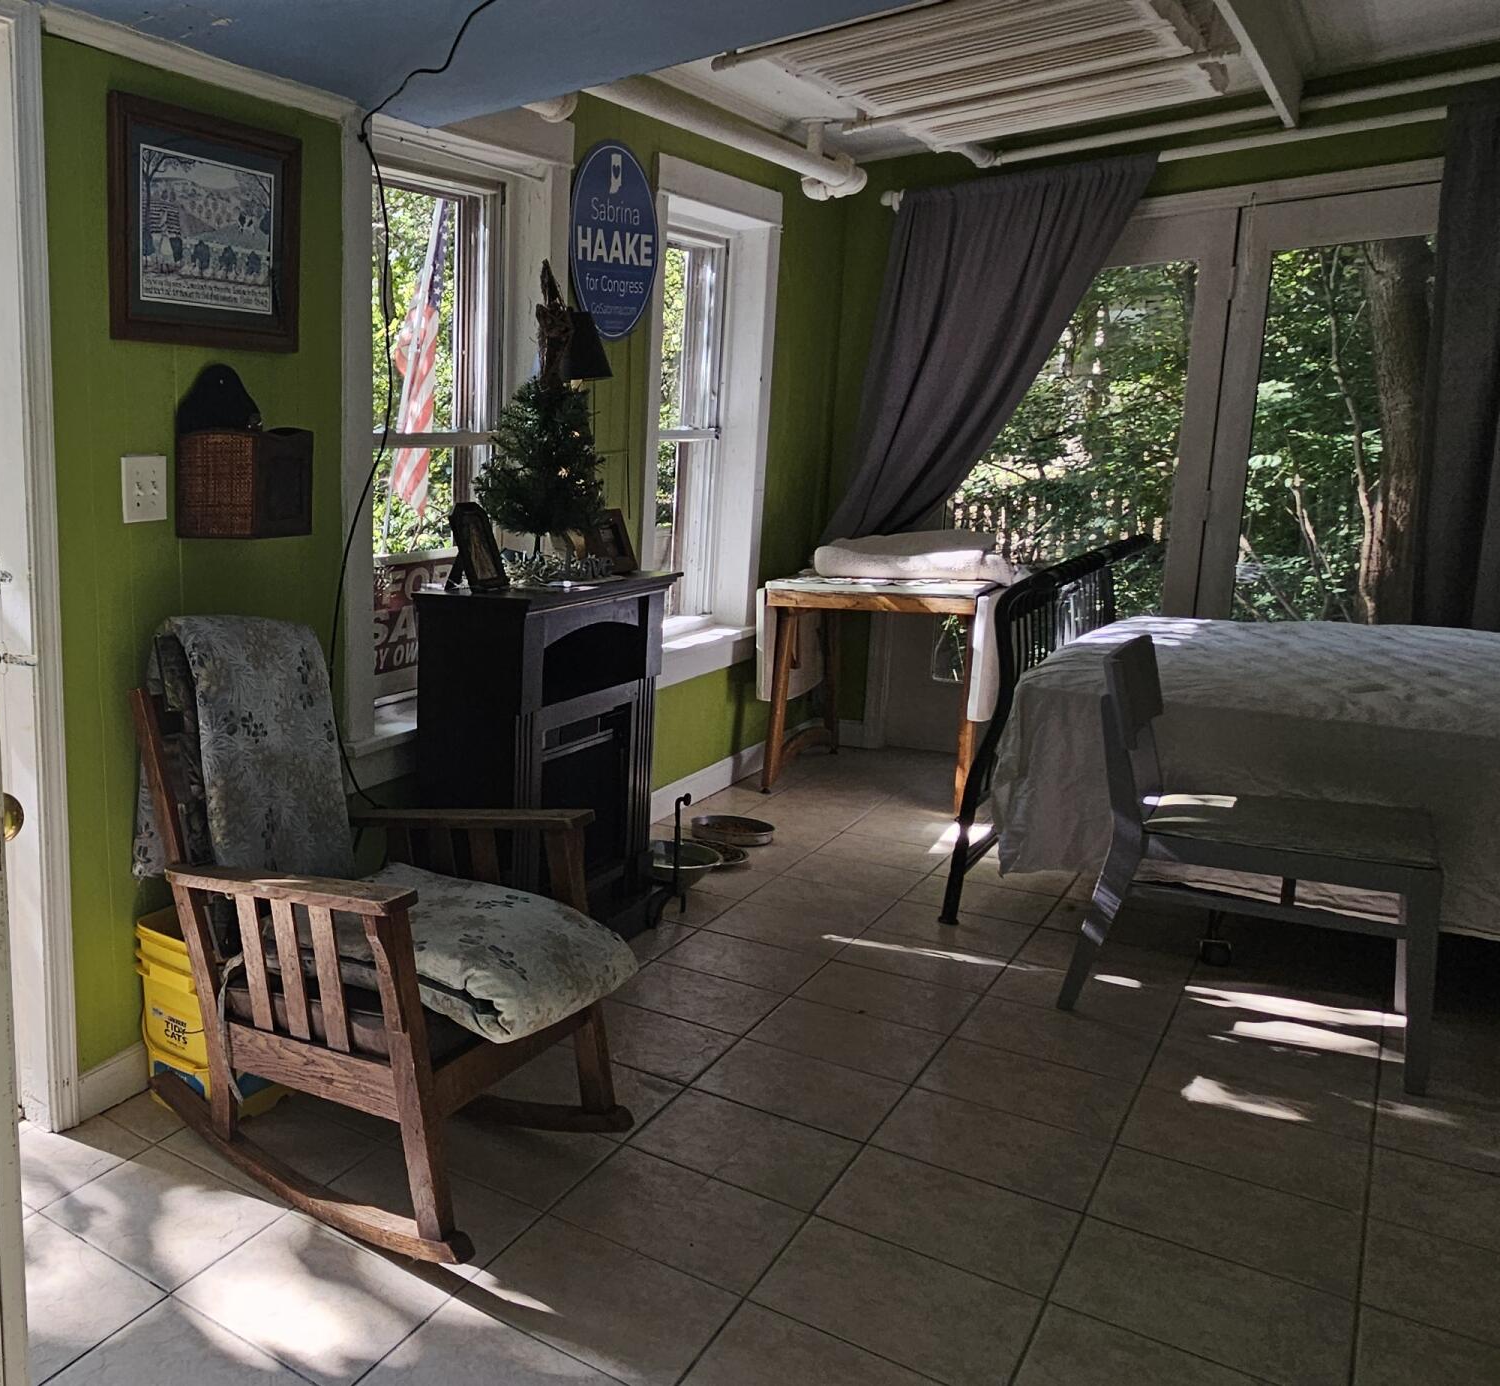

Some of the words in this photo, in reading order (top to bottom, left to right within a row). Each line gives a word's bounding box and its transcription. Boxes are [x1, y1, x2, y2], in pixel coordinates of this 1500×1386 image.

[591, 197, 640, 226] Sabrina
[577, 225, 653, 267] HAAKE
[585, 273, 599, 291] for
[601, 275, 644, 297] Congress
[374, 605, 417, 646] SA
[375, 648, 389, 670] Y
[164, 1020, 187, 1035] TIDY
[164, 1029, 188, 1045] CATS
